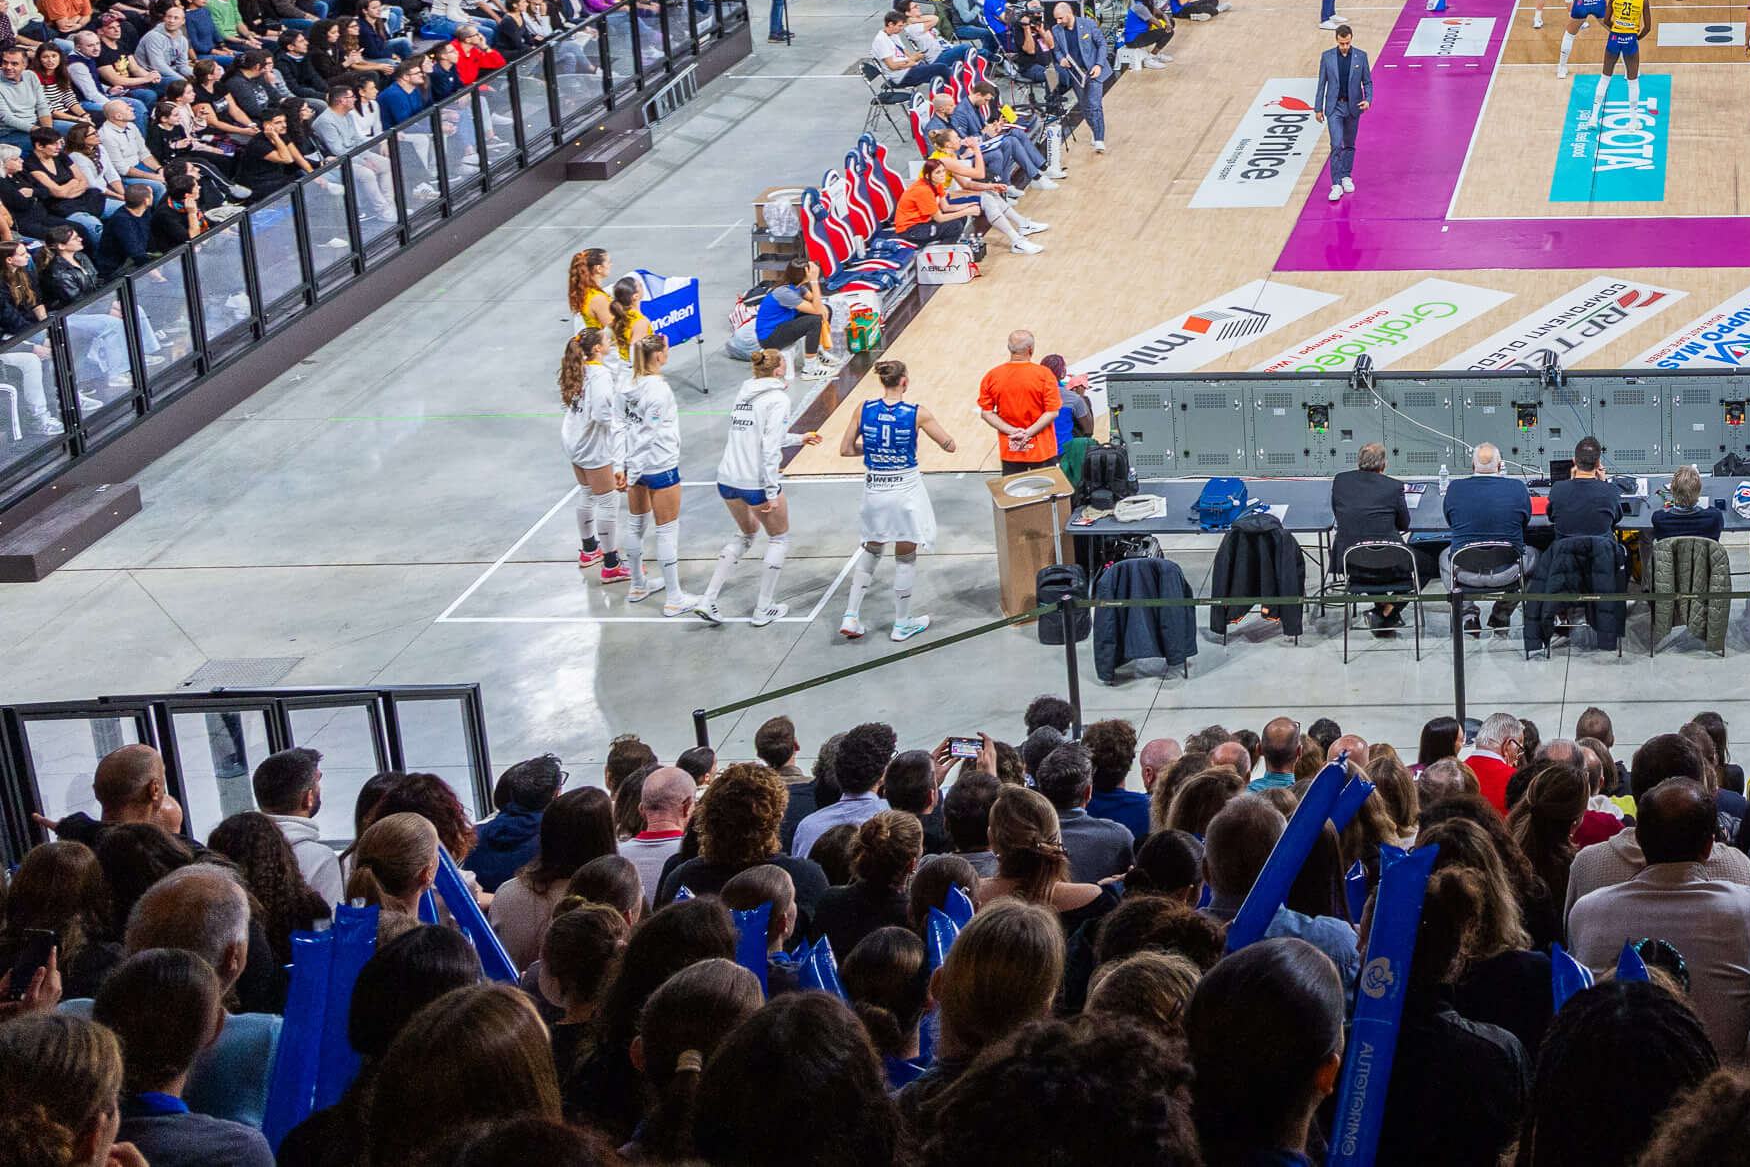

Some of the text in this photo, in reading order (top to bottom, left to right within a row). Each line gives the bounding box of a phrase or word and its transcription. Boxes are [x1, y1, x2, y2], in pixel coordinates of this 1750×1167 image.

[1621, 2, 1632, 16] 23
[1240, 112, 1311, 181] pernice
[1521, 283, 1628, 338] COMPONENTI
[881, 424, 891, 448] 9
